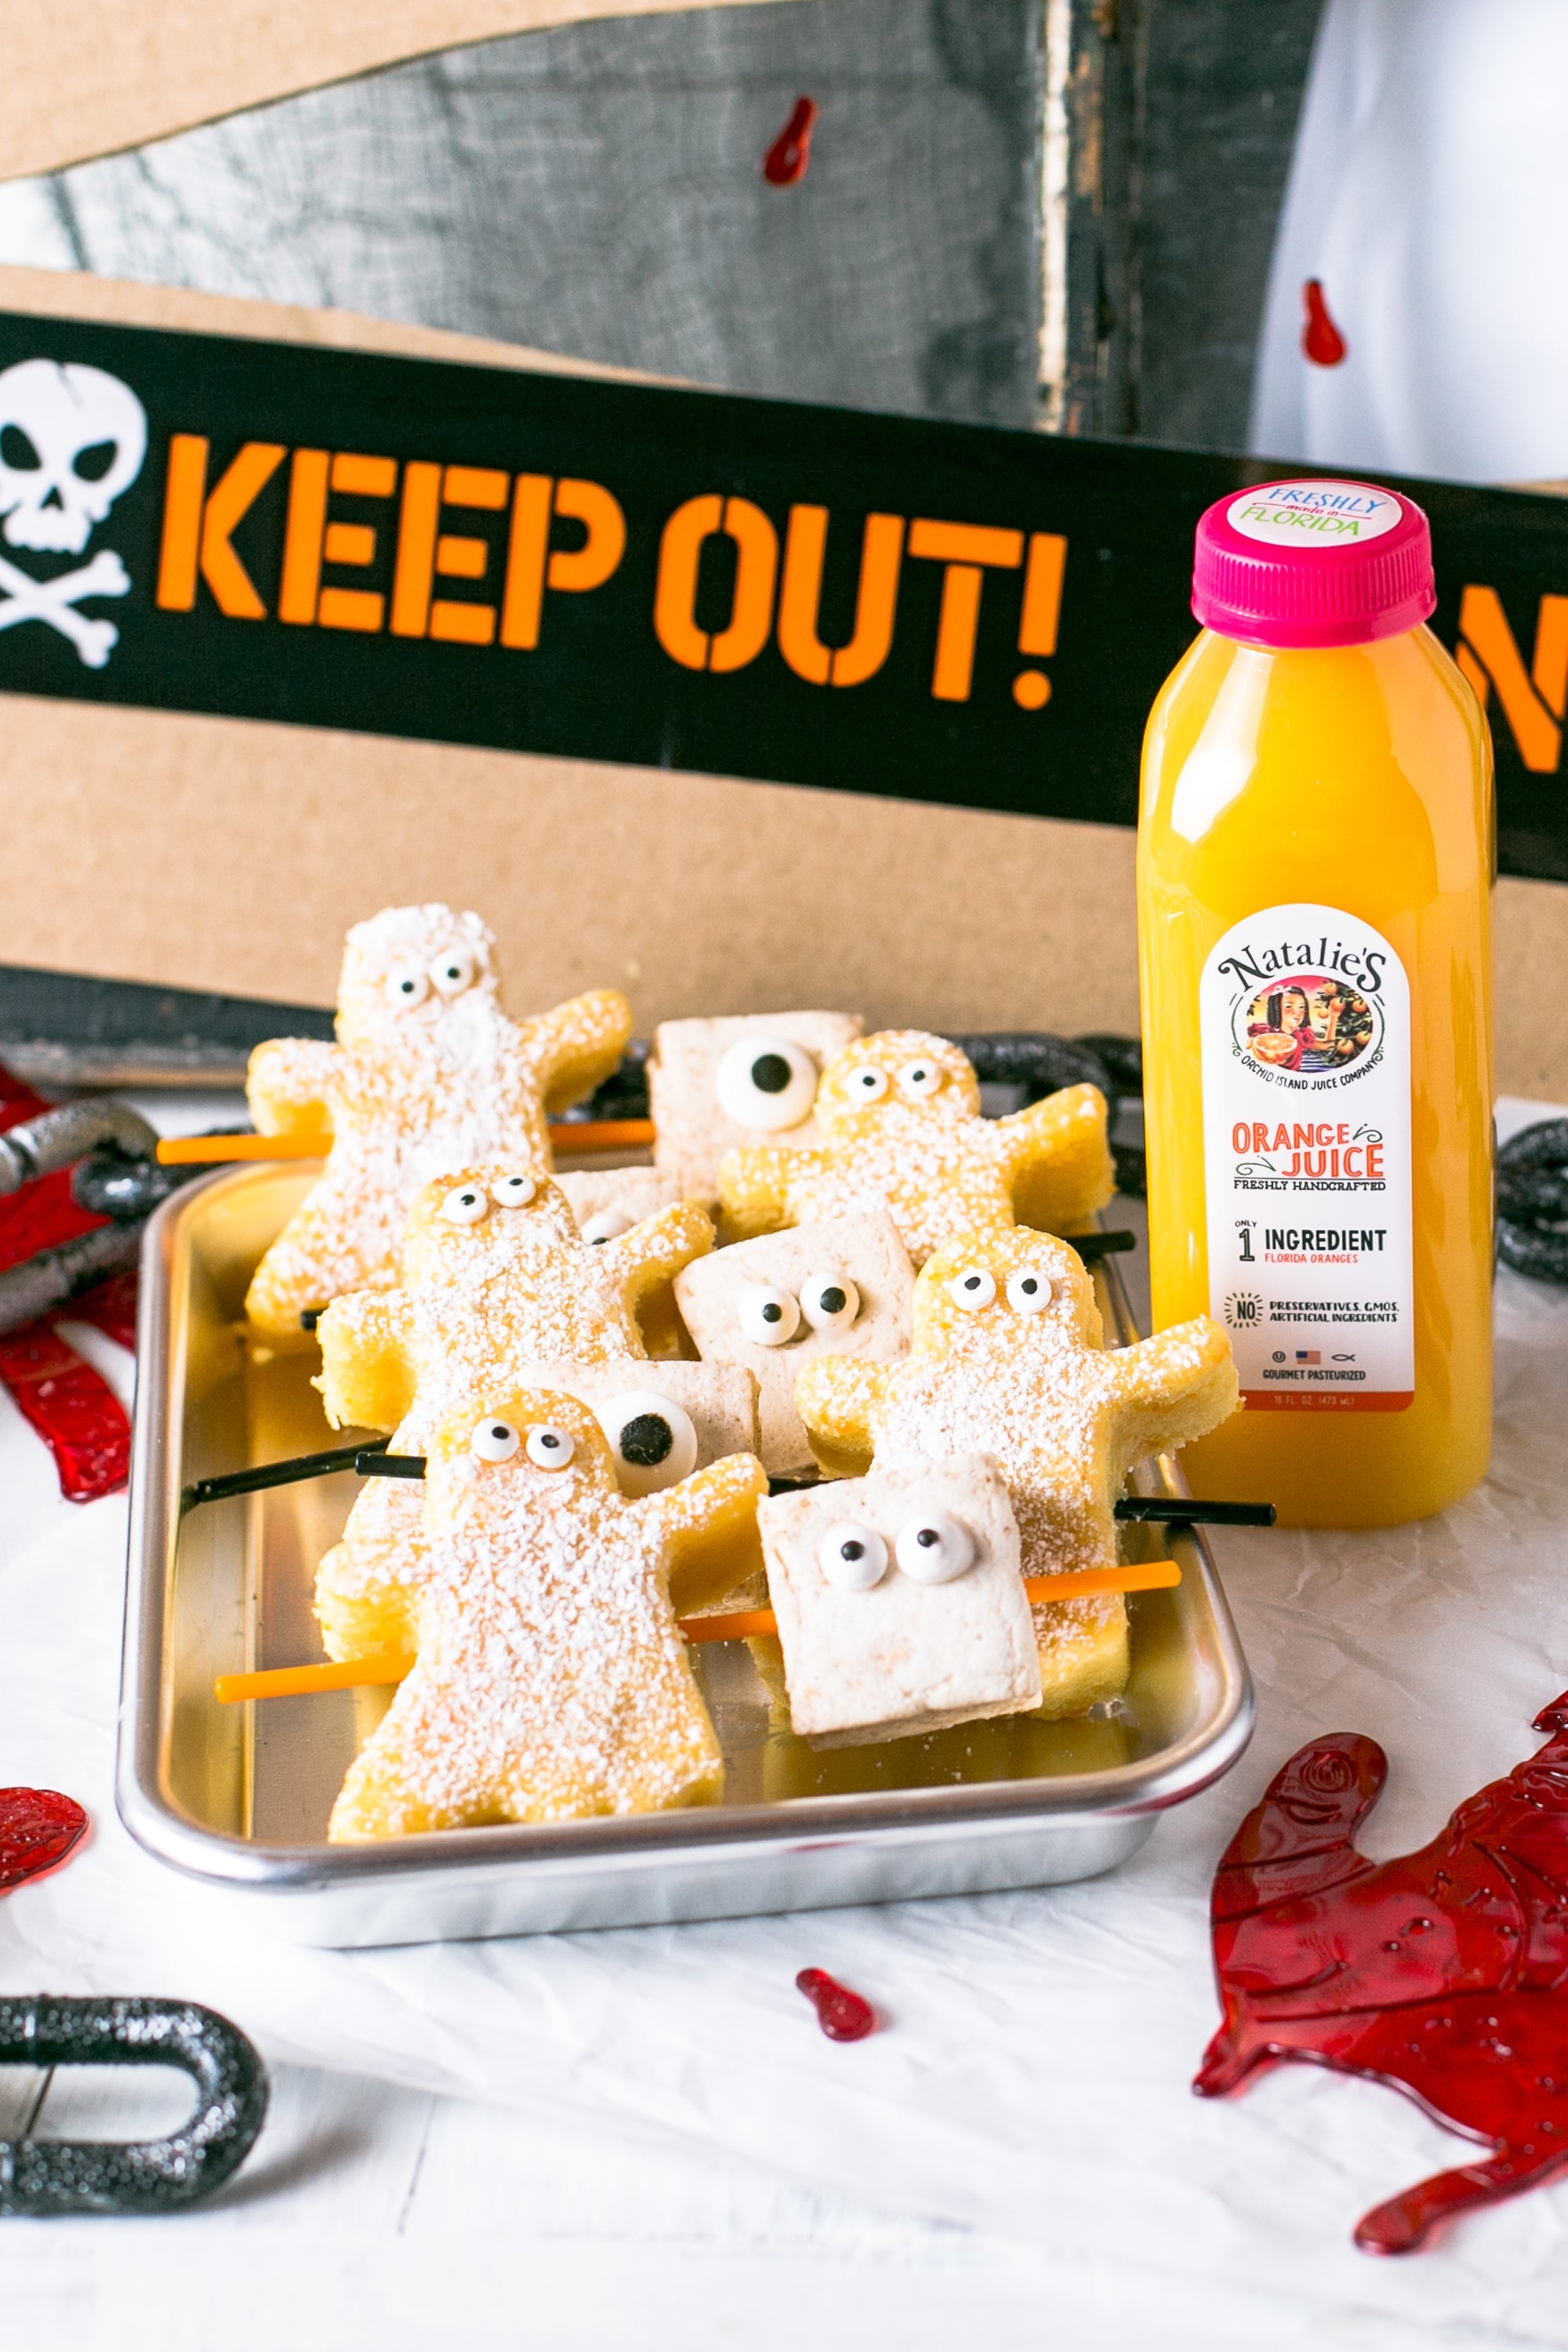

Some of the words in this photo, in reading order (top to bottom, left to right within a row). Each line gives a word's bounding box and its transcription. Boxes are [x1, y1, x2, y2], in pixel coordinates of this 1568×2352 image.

[1268, 488, 1387, 514] FRESHLY
[1285, 504, 1324, 515] made
[1240, 506, 1359, 536] FLORIDA
[155, 433, 627, 651] KEEP
[652, 492, 1069, 711] OUT!
[1241, 1055, 1274, 1083] ORCHID
[1275, 1076, 1308, 1090] ISLAND
[1311, 1077, 1338, 1091] JUICE
[1340, 1058, 1377, 1087] COMPANY
[1232, 1122, 1349, 1154] ORANGE
[1281, 1143, 1384, 1178] JUICE
[1233, 1179, 1288, 1191] FRESHLY
[1293, 1181, 1386, 1191] HANDCRAFTED
[1239, 1228, 1255, 1262] 1
[1265, 1229, 1387, 1251] INGREDIENT
[1265, 1253, 1307, 1263] FLORIDA
[1310, 1254, 1359, 1264] ORANGES
[1236, 1300, 1255, 1319] NO
[1269, 1312, 1330, 1323] ARTIFICIAL
[1332, 1313, 1398, 1323] INGREDIENTS
[1263, 1369, 1305, 1380] GOURMET
[1308, 1370, 1366, 1381] PASTEURIZED
[1319, 1396, 1337, 1405] (473
